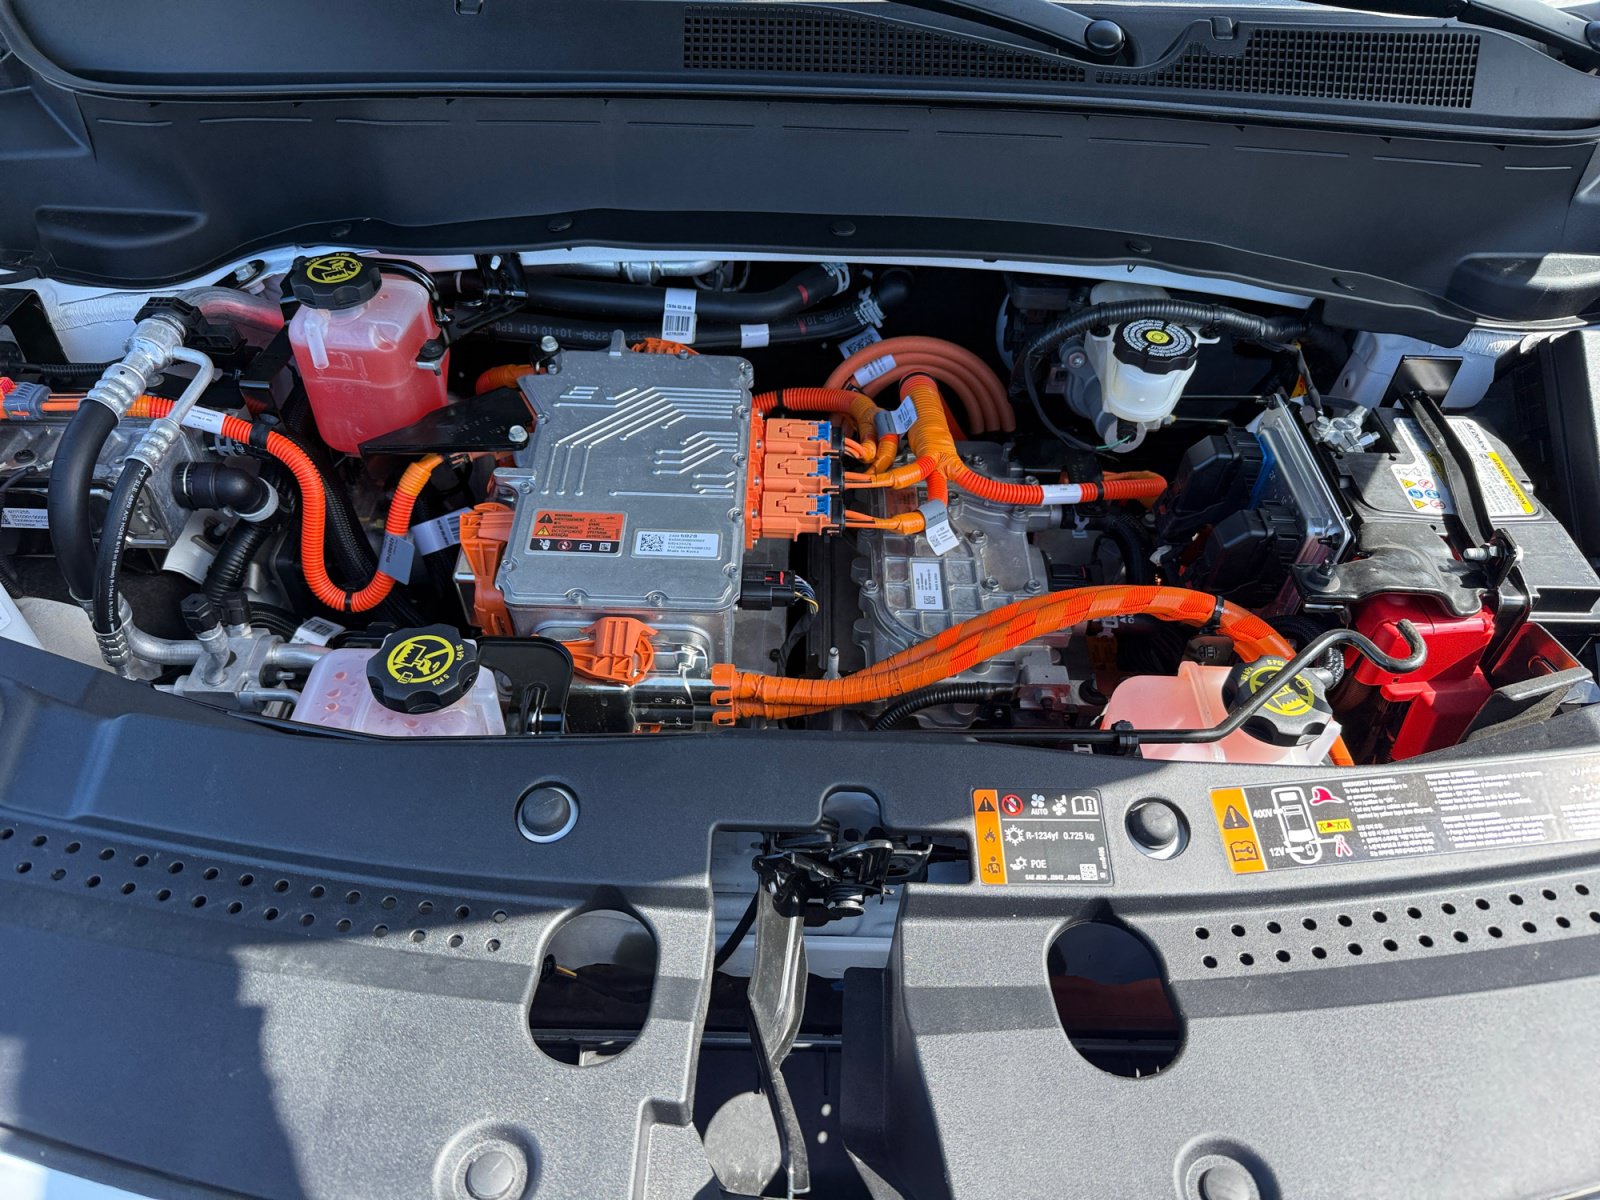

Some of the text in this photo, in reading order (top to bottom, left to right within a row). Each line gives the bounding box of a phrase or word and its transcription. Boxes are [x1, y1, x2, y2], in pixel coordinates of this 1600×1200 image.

[1253, 808, 1273, 818] 400V
[1026, 831, 1095, 842] R-1234yf 0.725 kg
[1269, 848, 1285, 857] 12V
[1030, 859, 1047, 869] POE
